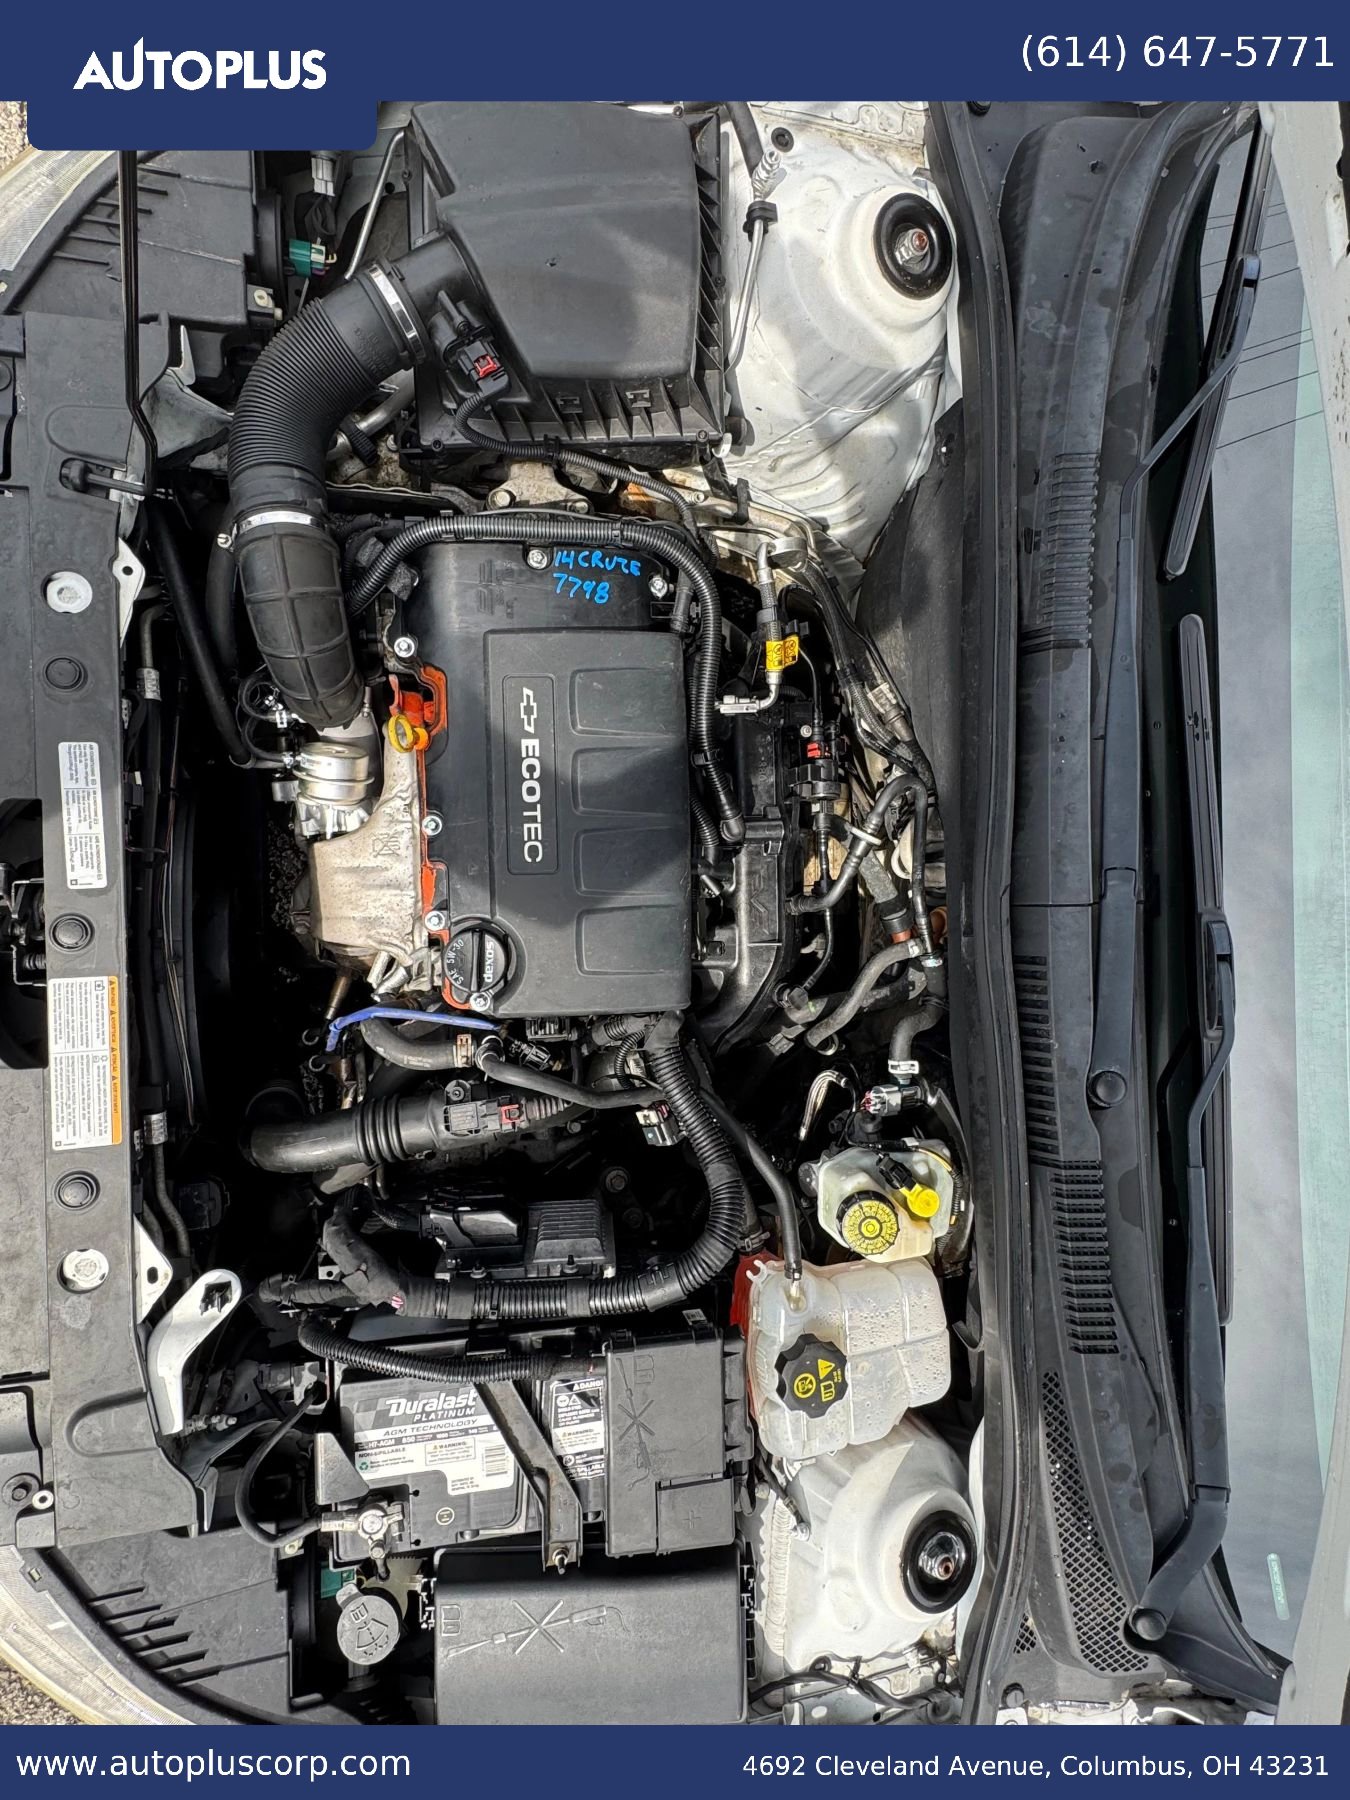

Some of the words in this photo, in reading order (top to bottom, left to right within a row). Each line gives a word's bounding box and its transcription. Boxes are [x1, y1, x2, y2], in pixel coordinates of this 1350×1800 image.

[552, 572, 610, 604] 7798
[520, 739, 543, 863] ECOTEC
[446, 939, 464, 964] 5W-30
[483, 941, 495, 982] dexos
[448, 968, 464, 985] SAE
[385, 1389, 478, 1417] Duralast
[414, 1407, 476, 1422] PLATINUM
[384, 1428, 408, 1436] AGM
[411, 1418, 478, 1432] TECHNOLOGY
